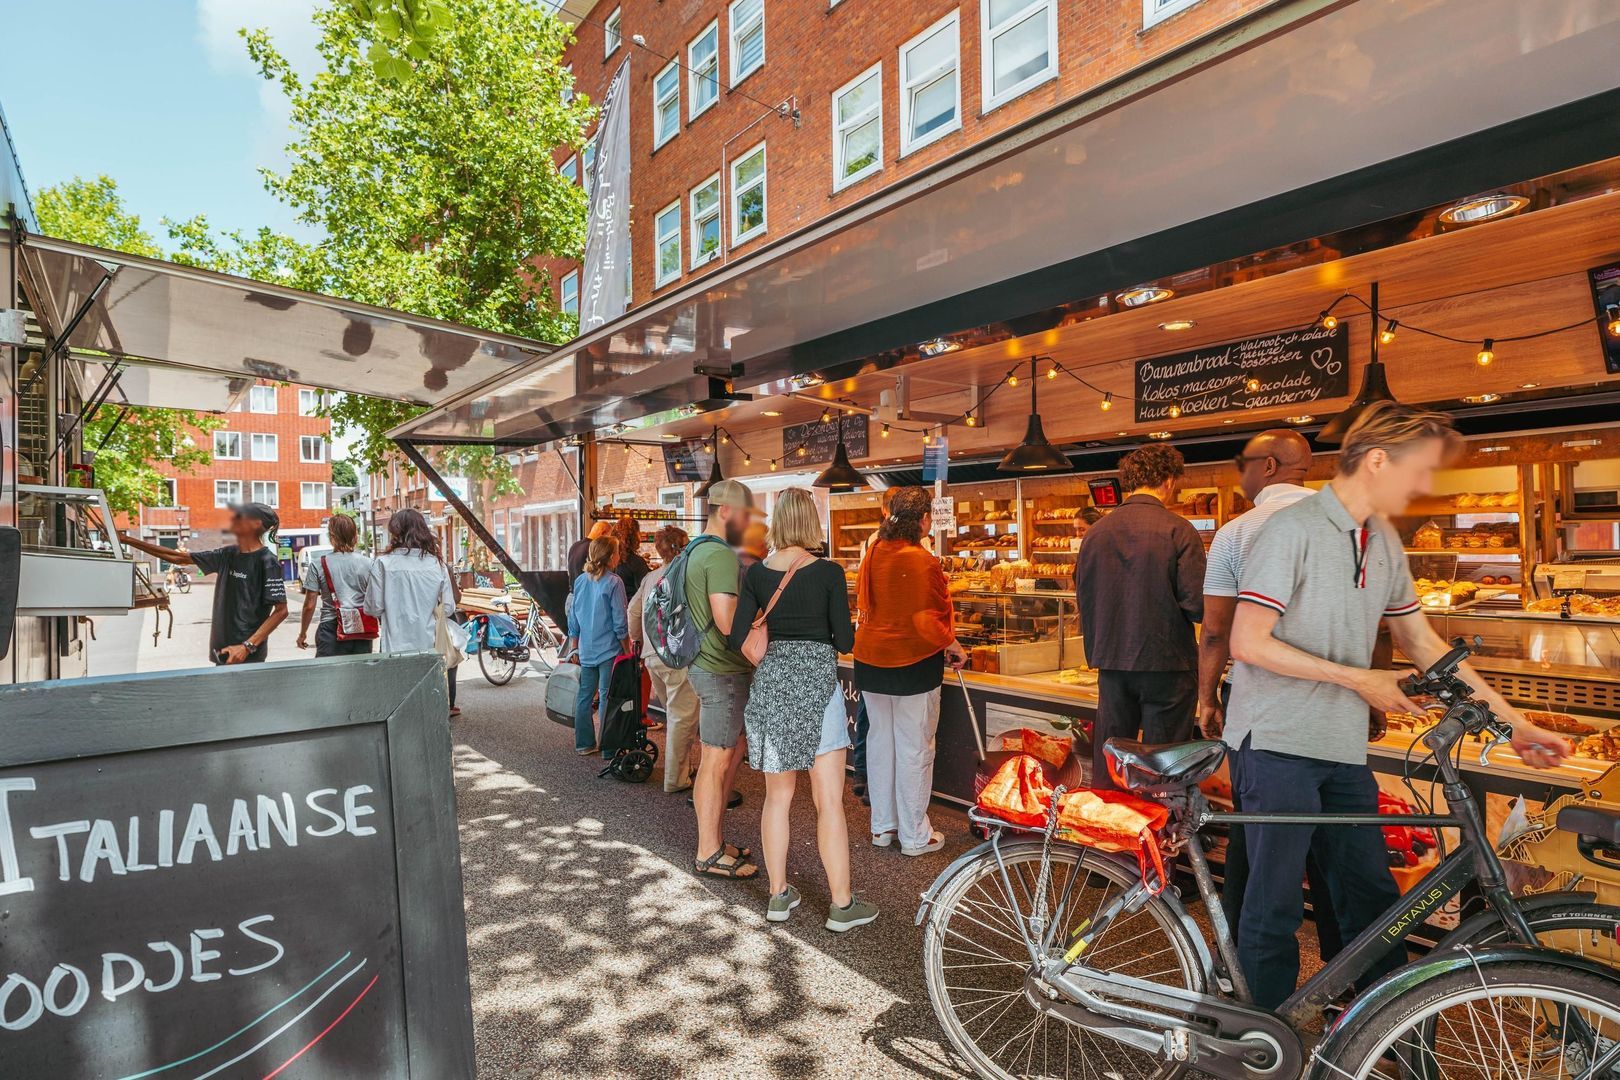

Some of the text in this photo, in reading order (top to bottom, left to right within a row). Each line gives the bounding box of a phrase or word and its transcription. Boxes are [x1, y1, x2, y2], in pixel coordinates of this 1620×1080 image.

[1139, 347, 1231, 383] Bananenbrood
[1142, 383, 1180, 402] Kokos
[1244, 371, 1311, 394] cocolade
[1388, 888, 1443, 937] BATAVUS
[1396, 992, 1444, 1022] CONTINENTAL
